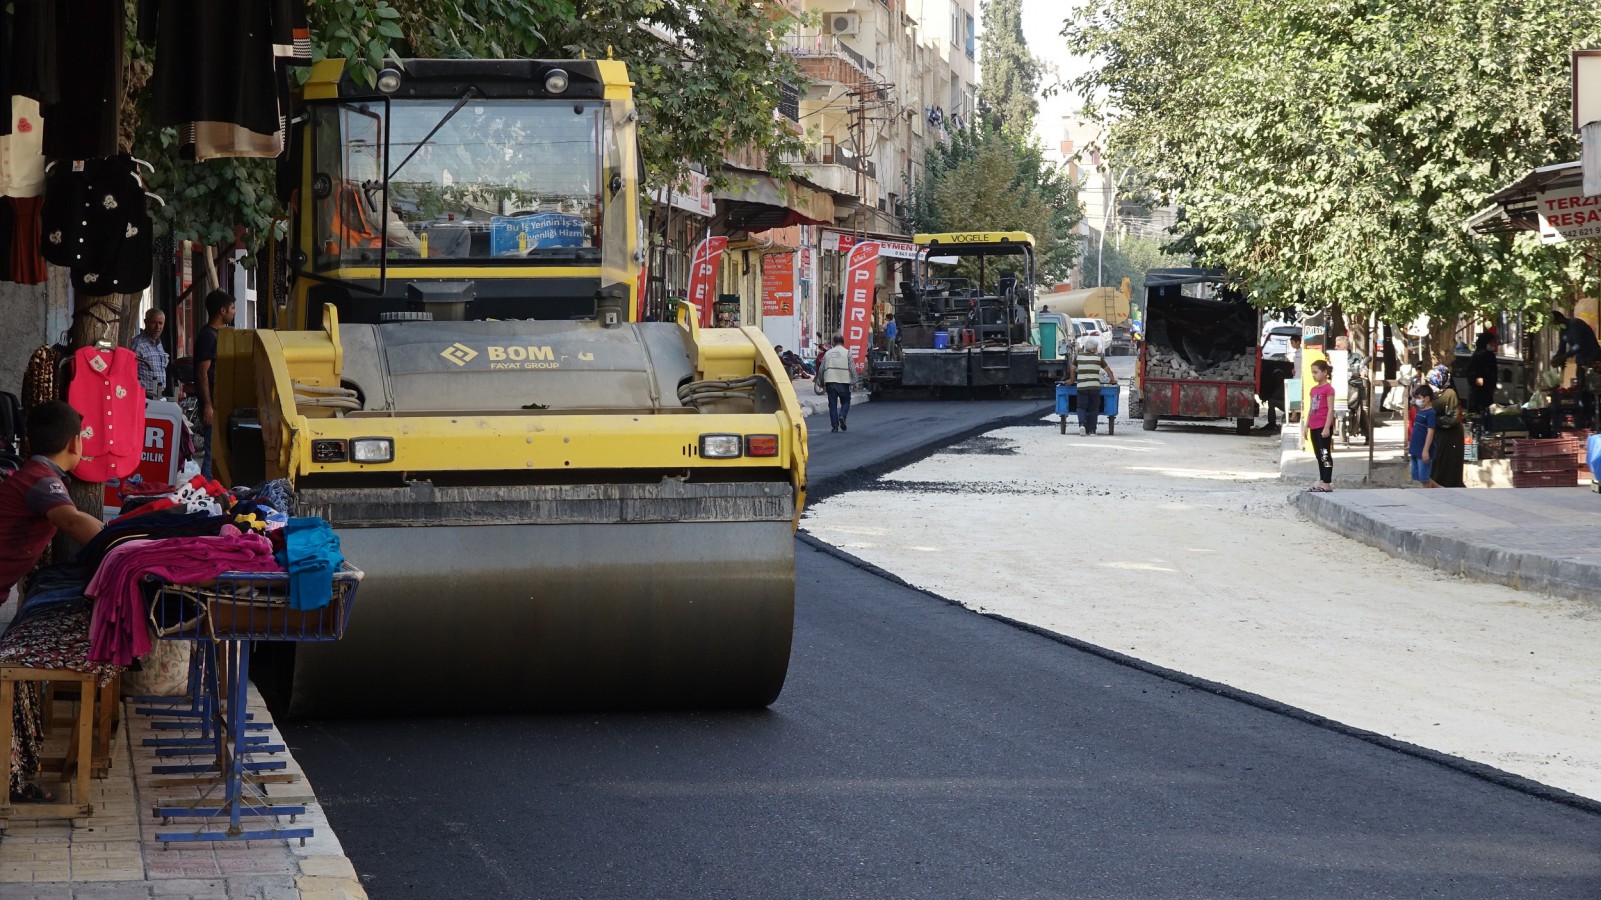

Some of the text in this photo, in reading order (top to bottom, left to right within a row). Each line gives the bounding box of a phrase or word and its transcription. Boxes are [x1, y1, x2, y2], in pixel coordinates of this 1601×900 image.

[506, 224, 519, 232] Bu
[530, 218, 560, 230] Yerinin
[1547, 208, 1601, 228] REŞA
[516, 228, 557, 242] Gvenliği
[1579, 228, 1593, 236] 621
[849, 269, 870, 360] PERDE
[144, 426, 165, 449] R
[140, 451, 164, 463] CILIK
